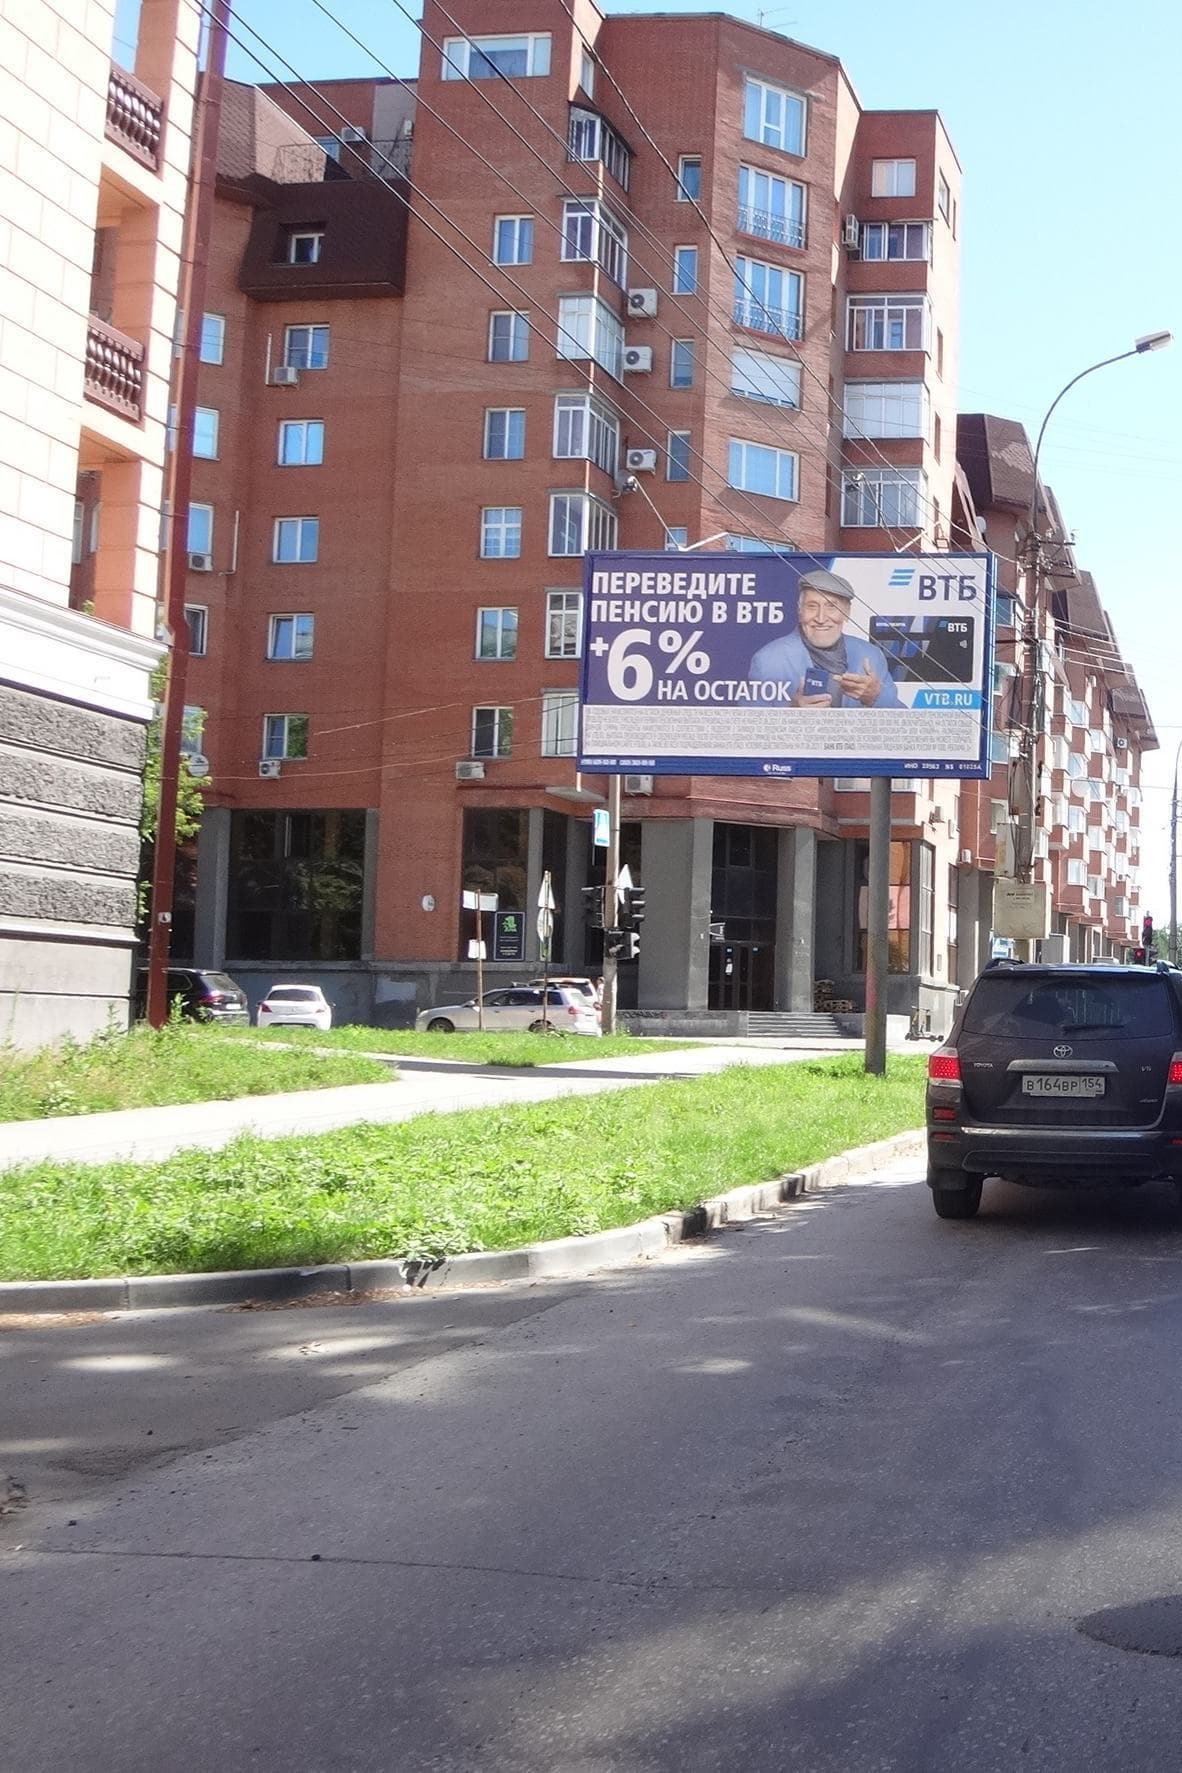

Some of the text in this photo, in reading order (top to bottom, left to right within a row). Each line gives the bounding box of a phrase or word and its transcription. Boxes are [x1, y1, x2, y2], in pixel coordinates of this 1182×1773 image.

[592, 572, 757, 600] ПЕРЕВЕДИТЕ
[918, 575, 977, 601] ВТБ
[591, 600, 785, 624] ПЕНСИЮ В ВТБ
[947, 622, 968, 632] ВТБ
[657, 680, 792, 702] НА ОСТАТОК
[924, 693, 973, 706] VTB.RU
[1082, 1079, 1102, 1089] 154
